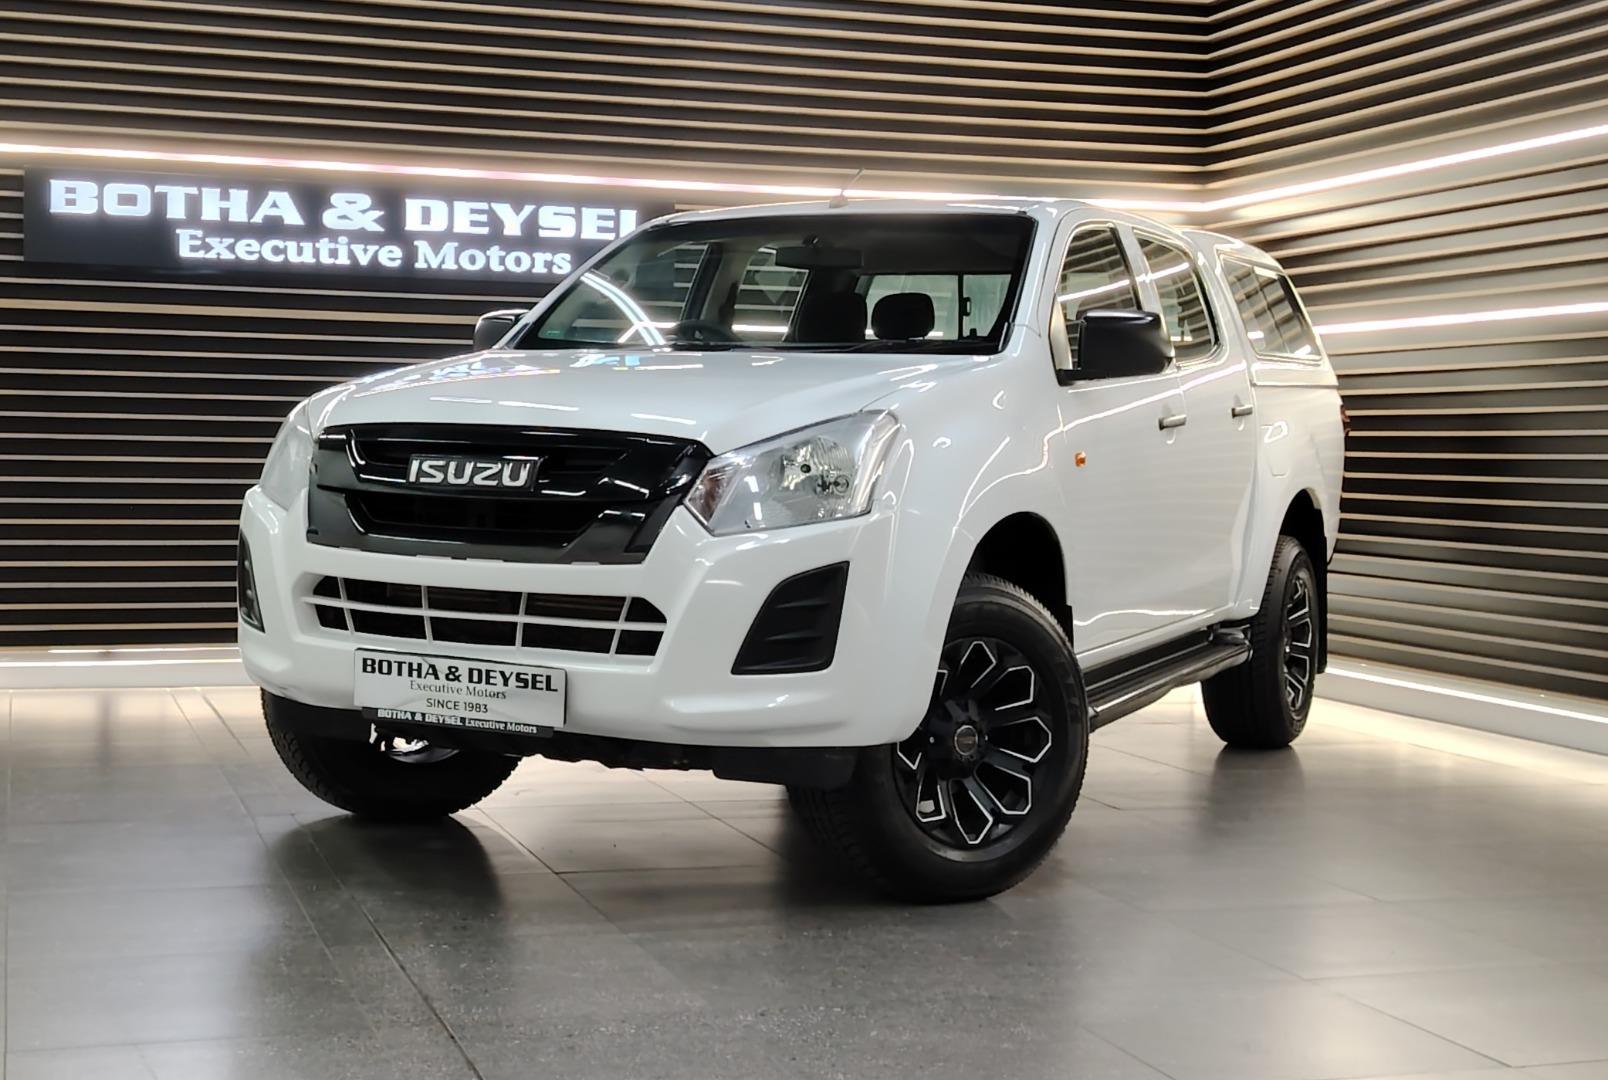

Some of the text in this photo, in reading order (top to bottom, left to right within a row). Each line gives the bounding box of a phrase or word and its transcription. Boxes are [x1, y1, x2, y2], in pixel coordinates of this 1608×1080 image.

[48, 178, 305, 226] BOTHA
[322, 192, 384, 232] &
[176, 228, 572, 275] Executive Motors
[409, 459, 531, 487] ISUZU
[362, 657, 558, 692] BOTHA & DEYSEL
[410, 680, 507, 700] Executive Motors
[426, 698, 488, 713] SINCE 1983
[377, 708, 537, 734] BOTHA & DEYSEL Executive Motors
